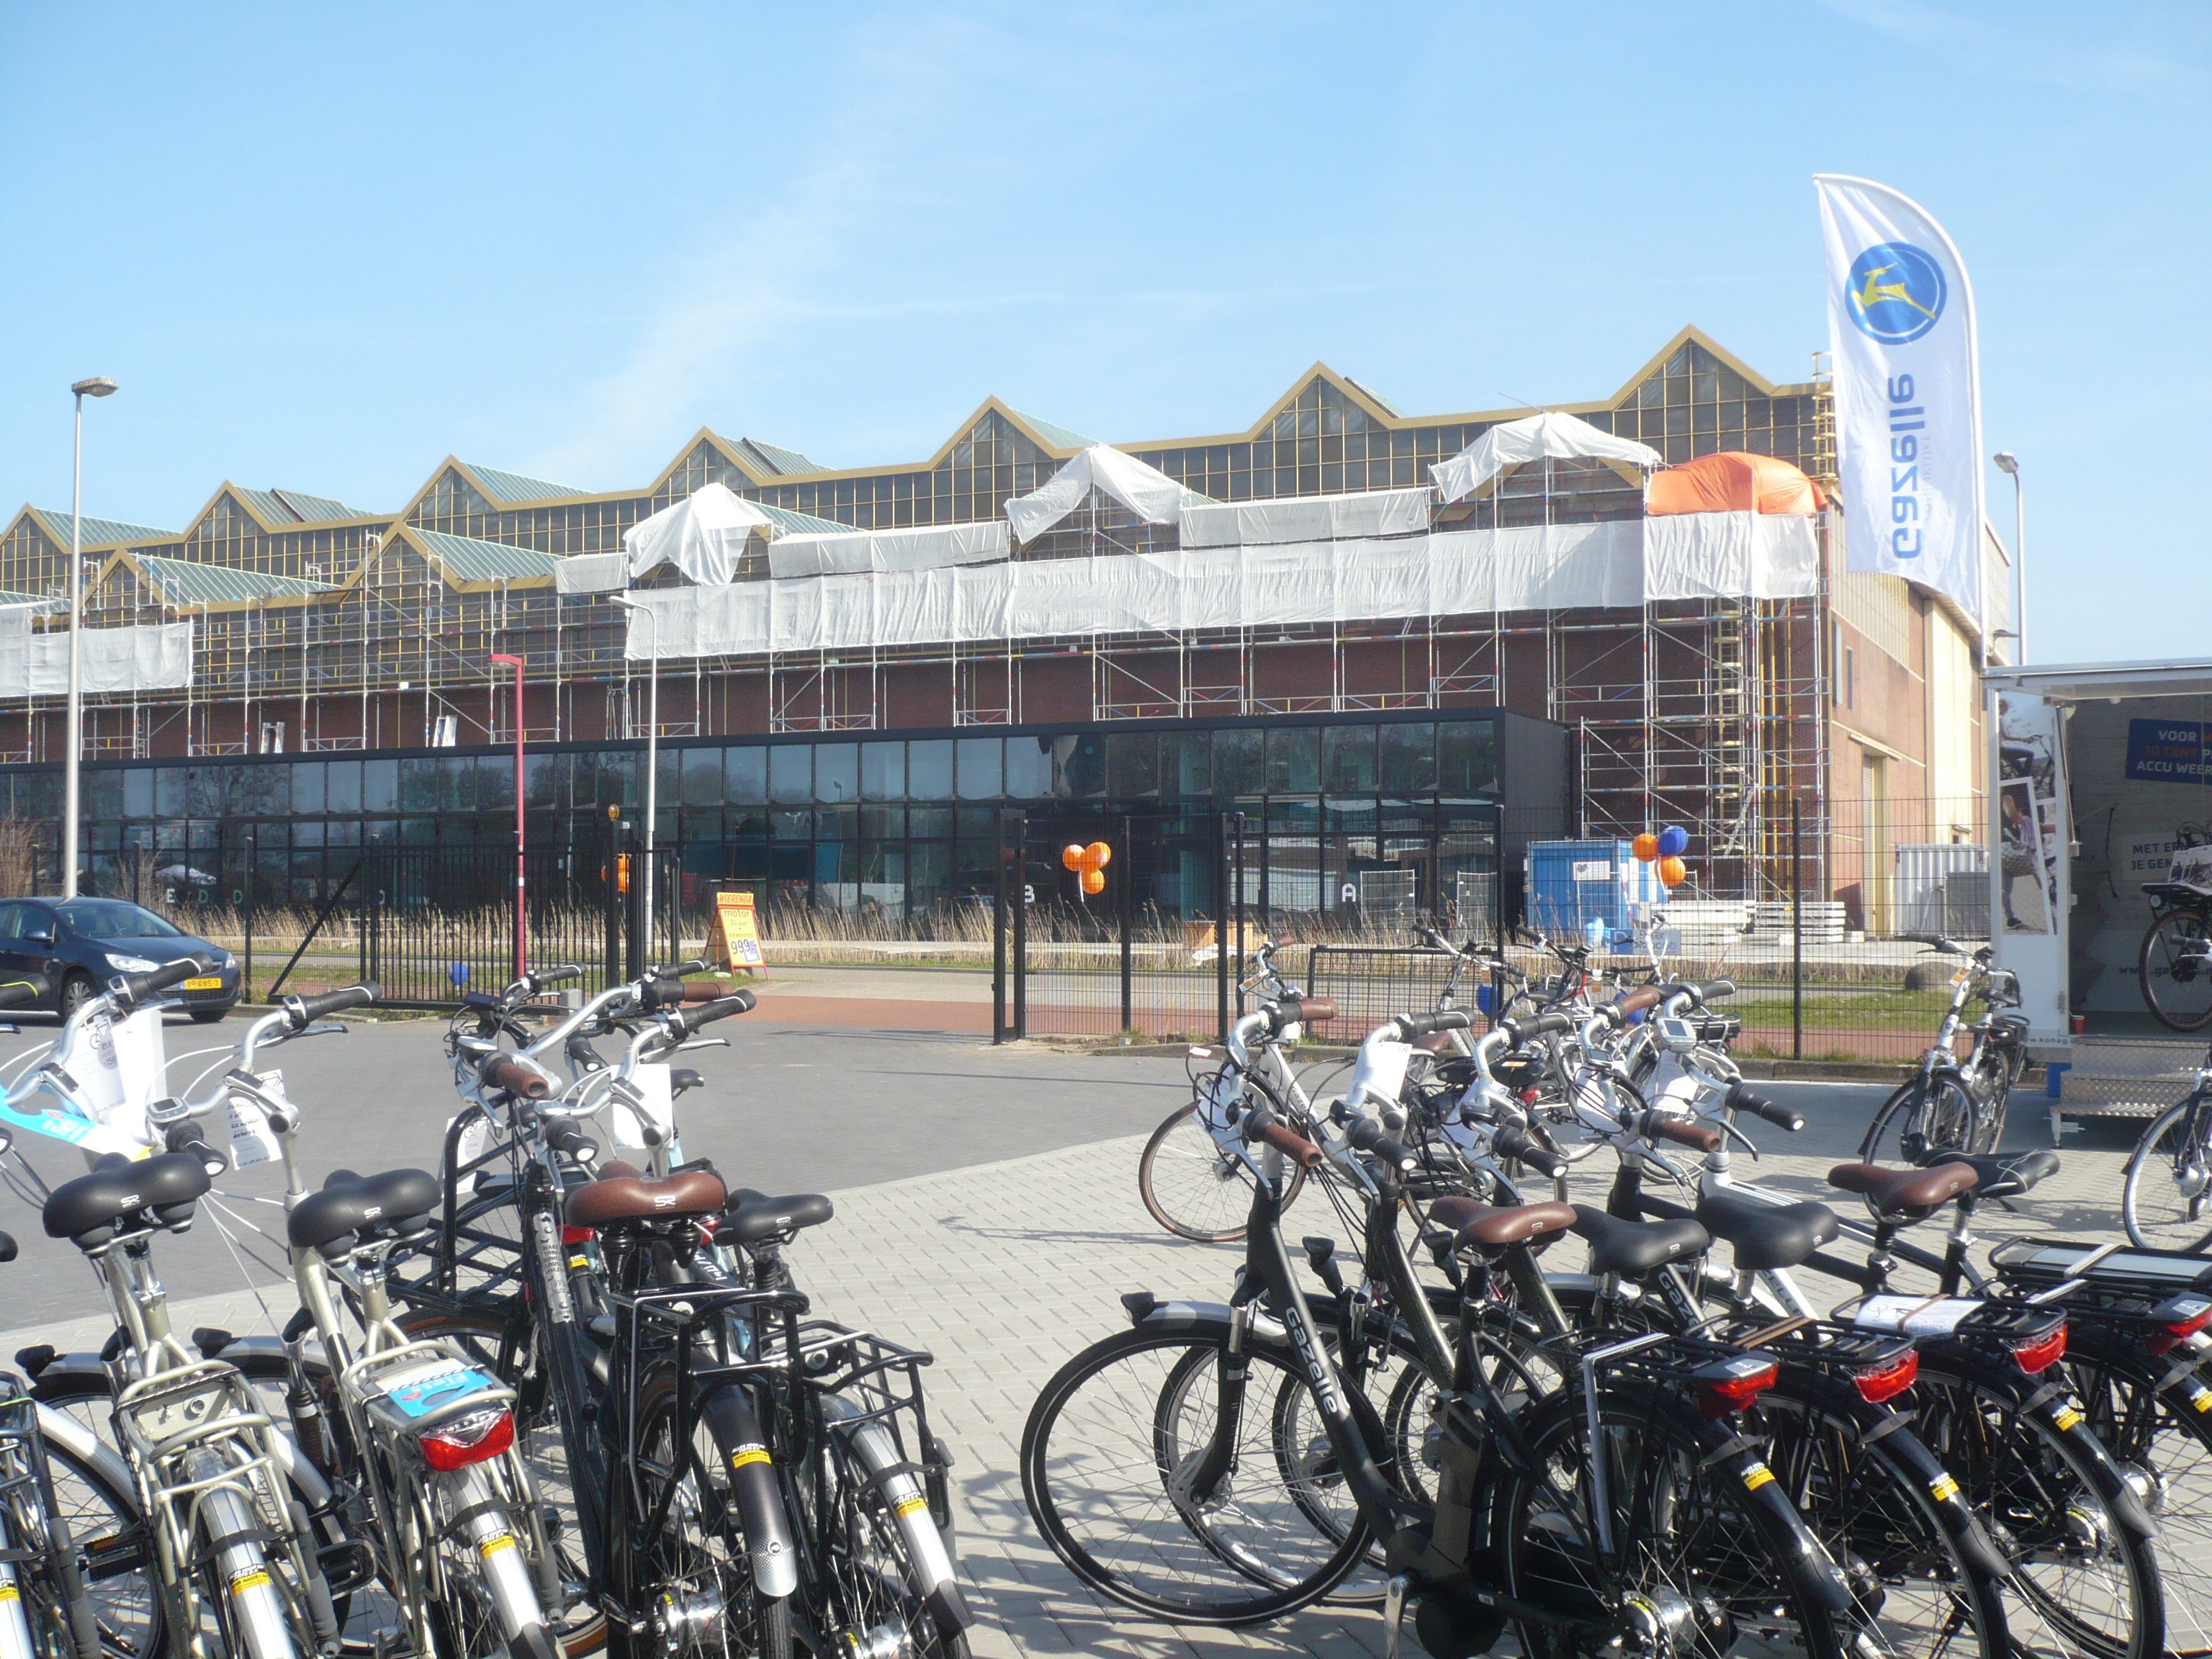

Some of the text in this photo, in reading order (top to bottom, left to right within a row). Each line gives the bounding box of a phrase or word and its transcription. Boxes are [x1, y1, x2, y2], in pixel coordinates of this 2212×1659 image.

[2158, 729, 2197, 742] VOOR
[2136, 760, 2173, 773] ACCU
[2132, 843, 2159, 855] MET
[2131, 860, 2144, 871] JE
[719, 894, 752, 904] WIERENGA
[1341, 883, 1357, 903] A
[724, 909, 750, 918] motor
[1285, 1306, 1338, 1416] Gazelle
